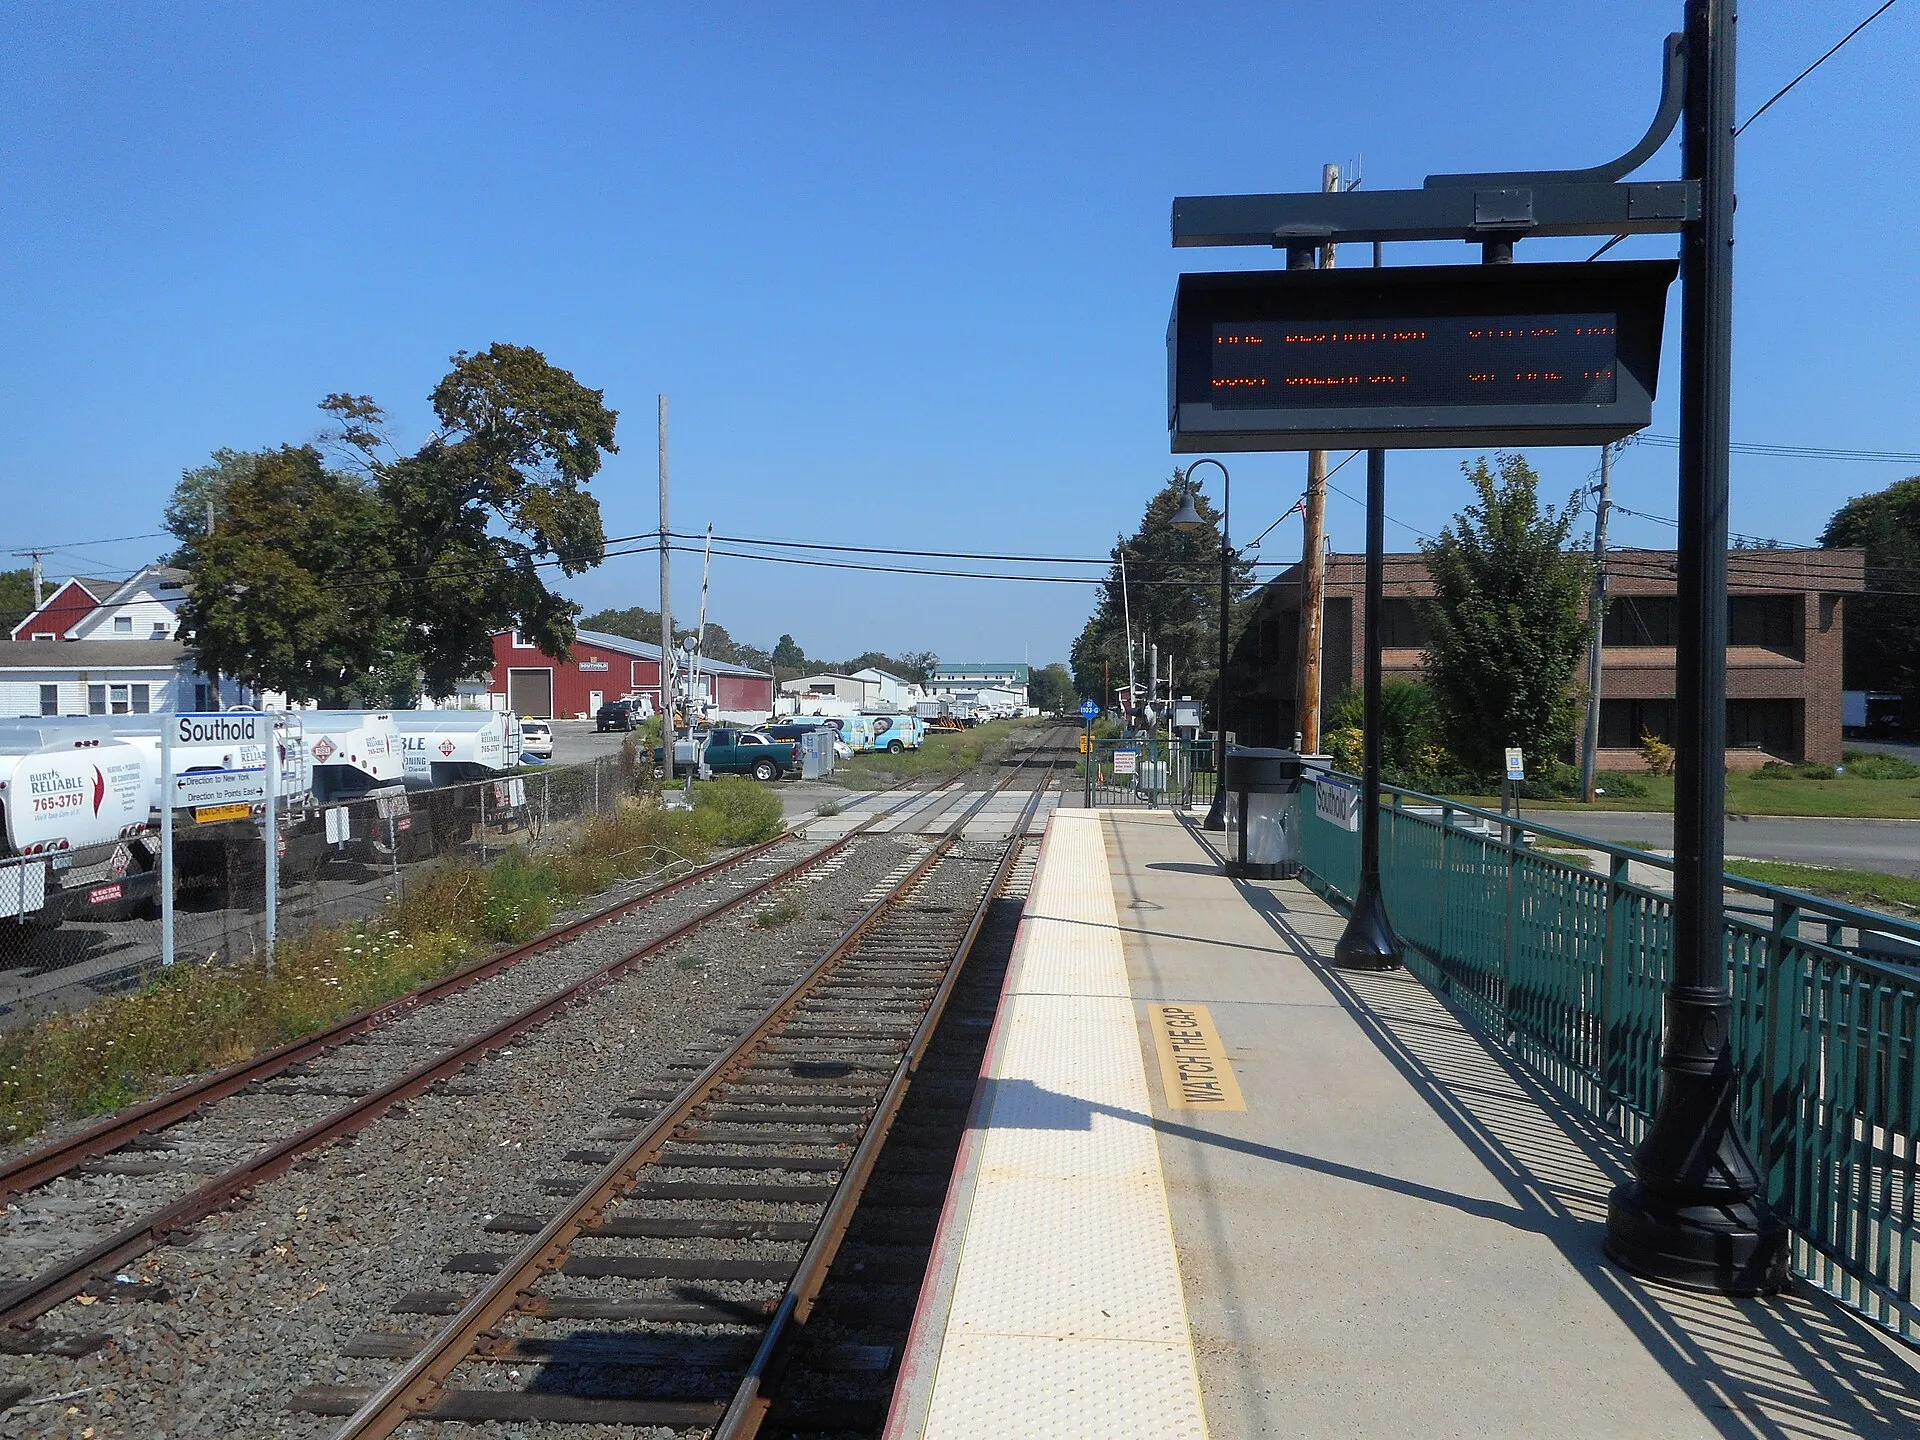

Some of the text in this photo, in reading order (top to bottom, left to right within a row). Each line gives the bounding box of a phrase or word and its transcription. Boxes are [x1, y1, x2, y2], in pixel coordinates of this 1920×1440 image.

[180, 717, 255, 742] Southold
[241, 751, 267, 762] RELIAB
[31, 777, 83, 793] RELIABLE
[186, 777, 213, 786] Direction
[238, 773, 250, 781] York
[33, 792, 84, 811] 765-3767
[188, 792, 215, 801] Direction
[224, 789, 242, 797] Points
[243, 787, 255, 796] East
[1316, 780, 1347, 820] Southold
[197, 803, 249, 817] WATCH THE GAP
[1162, 1007, 1225, 1102] WATCH THE GAP
